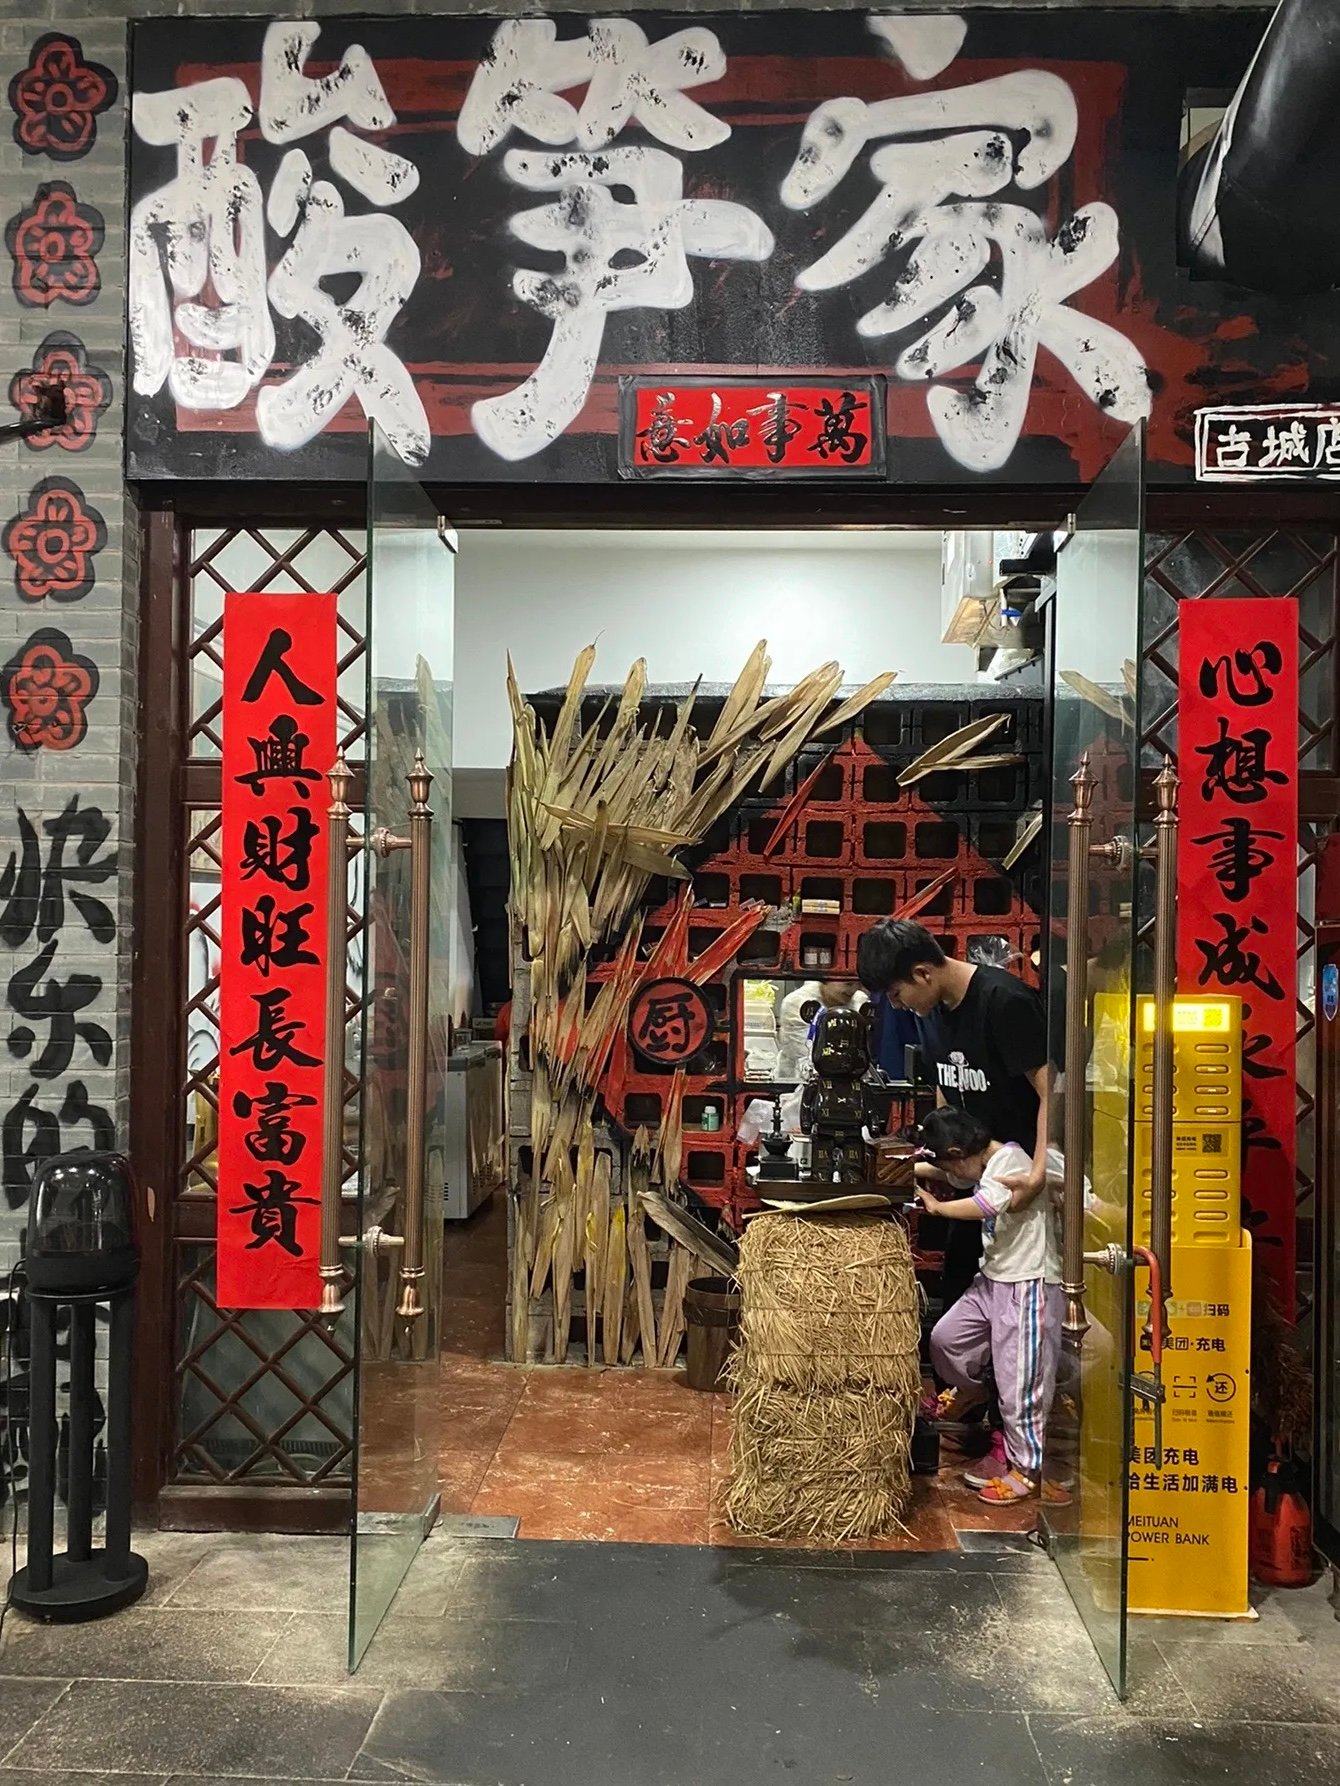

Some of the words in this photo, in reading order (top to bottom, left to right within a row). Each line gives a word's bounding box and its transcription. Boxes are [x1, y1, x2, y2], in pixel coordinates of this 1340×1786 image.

[131, 15, 1153, 472] 酸笋家
[228, 628, 327, 1257] 人興財旺長富貴
[638, 991, 696, 1054] 厨
[936, 1062, 958, 1088] THE
[1204, 1303, 1230, 1317] 扫码
[1214, 1381, 1228, 1395] 还
[1175, 1533, 1210, 1545] BANK
